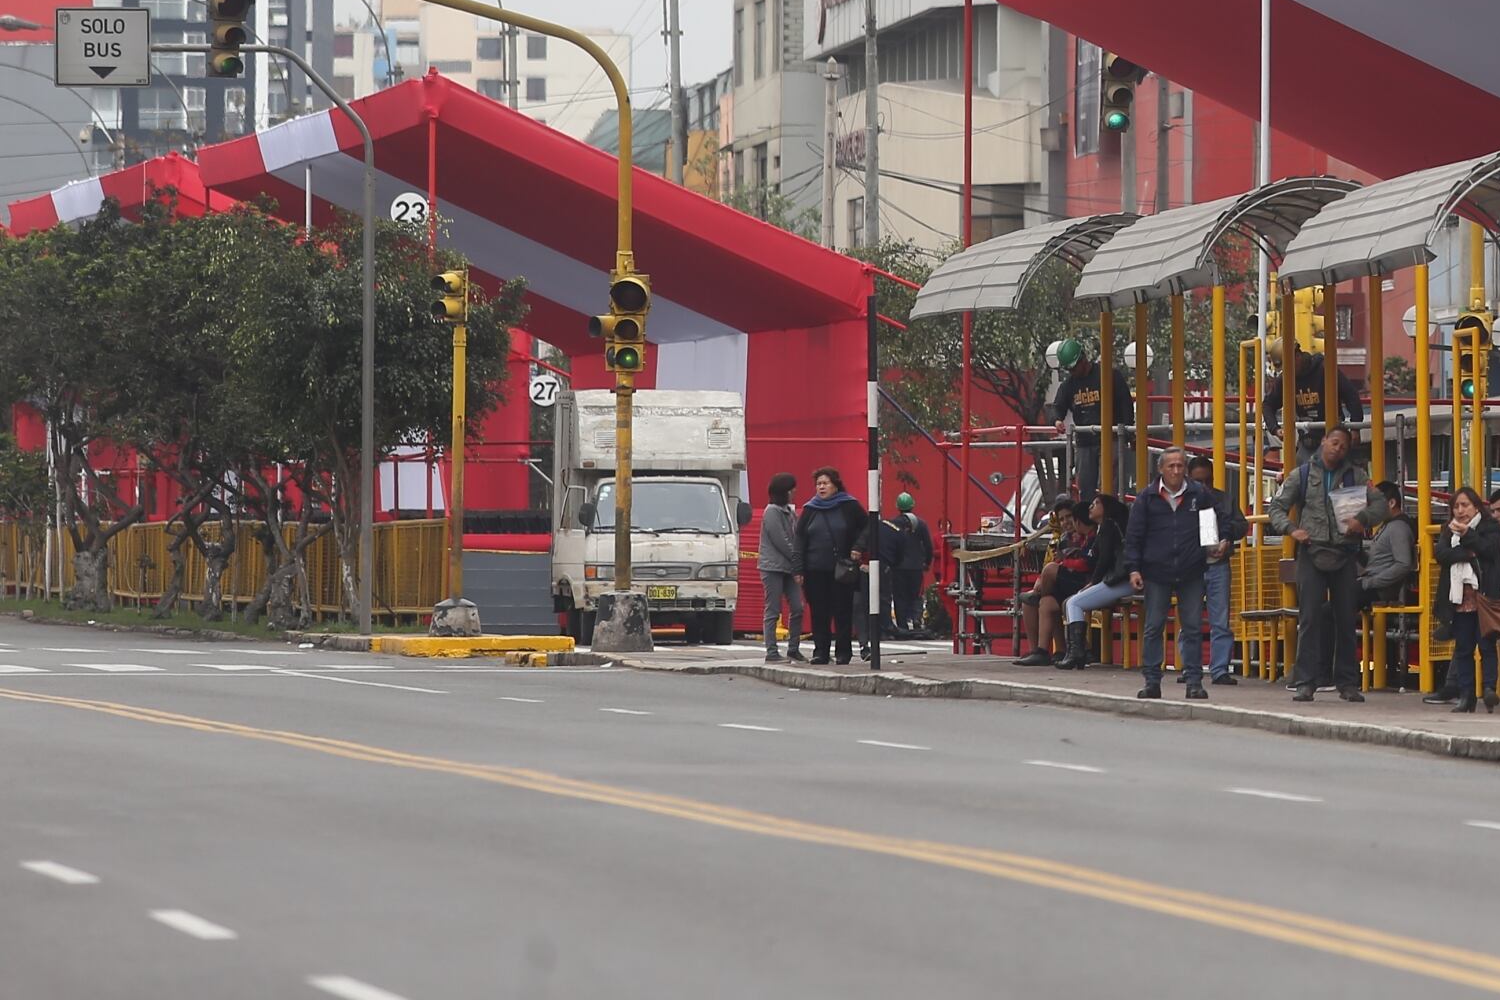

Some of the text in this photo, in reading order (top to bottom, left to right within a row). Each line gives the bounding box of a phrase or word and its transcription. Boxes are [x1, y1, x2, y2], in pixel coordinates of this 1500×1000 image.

[81, 18, 125, 34] SOLO
[84, 42, 122, 58] BUS
[395, 201, 425, 223] 23
[533, 382, 557, 400] 27
